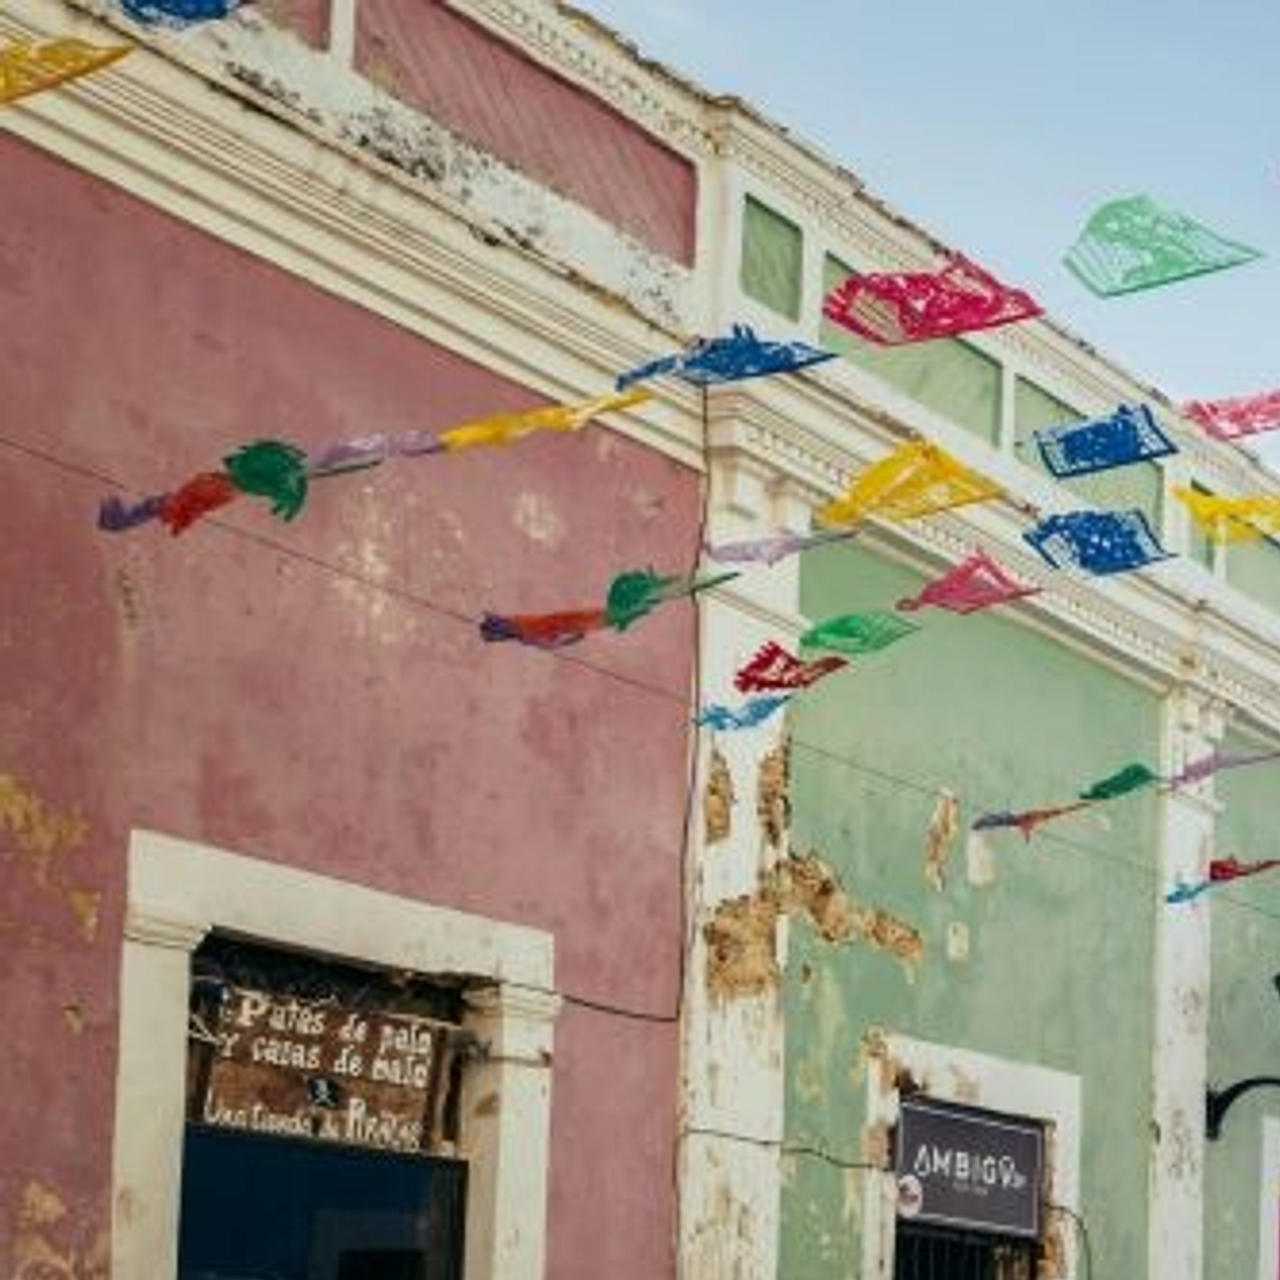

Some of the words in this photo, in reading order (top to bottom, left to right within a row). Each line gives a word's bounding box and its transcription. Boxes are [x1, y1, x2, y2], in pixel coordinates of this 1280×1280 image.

[235, 995, 325, 1035] Patas
[339, 1013, 368, 1042] de
[380, 1024, 432, 1054] palo
[253, 1037, 321, 1070] caras
[334, 1044, 363, 1076] de
